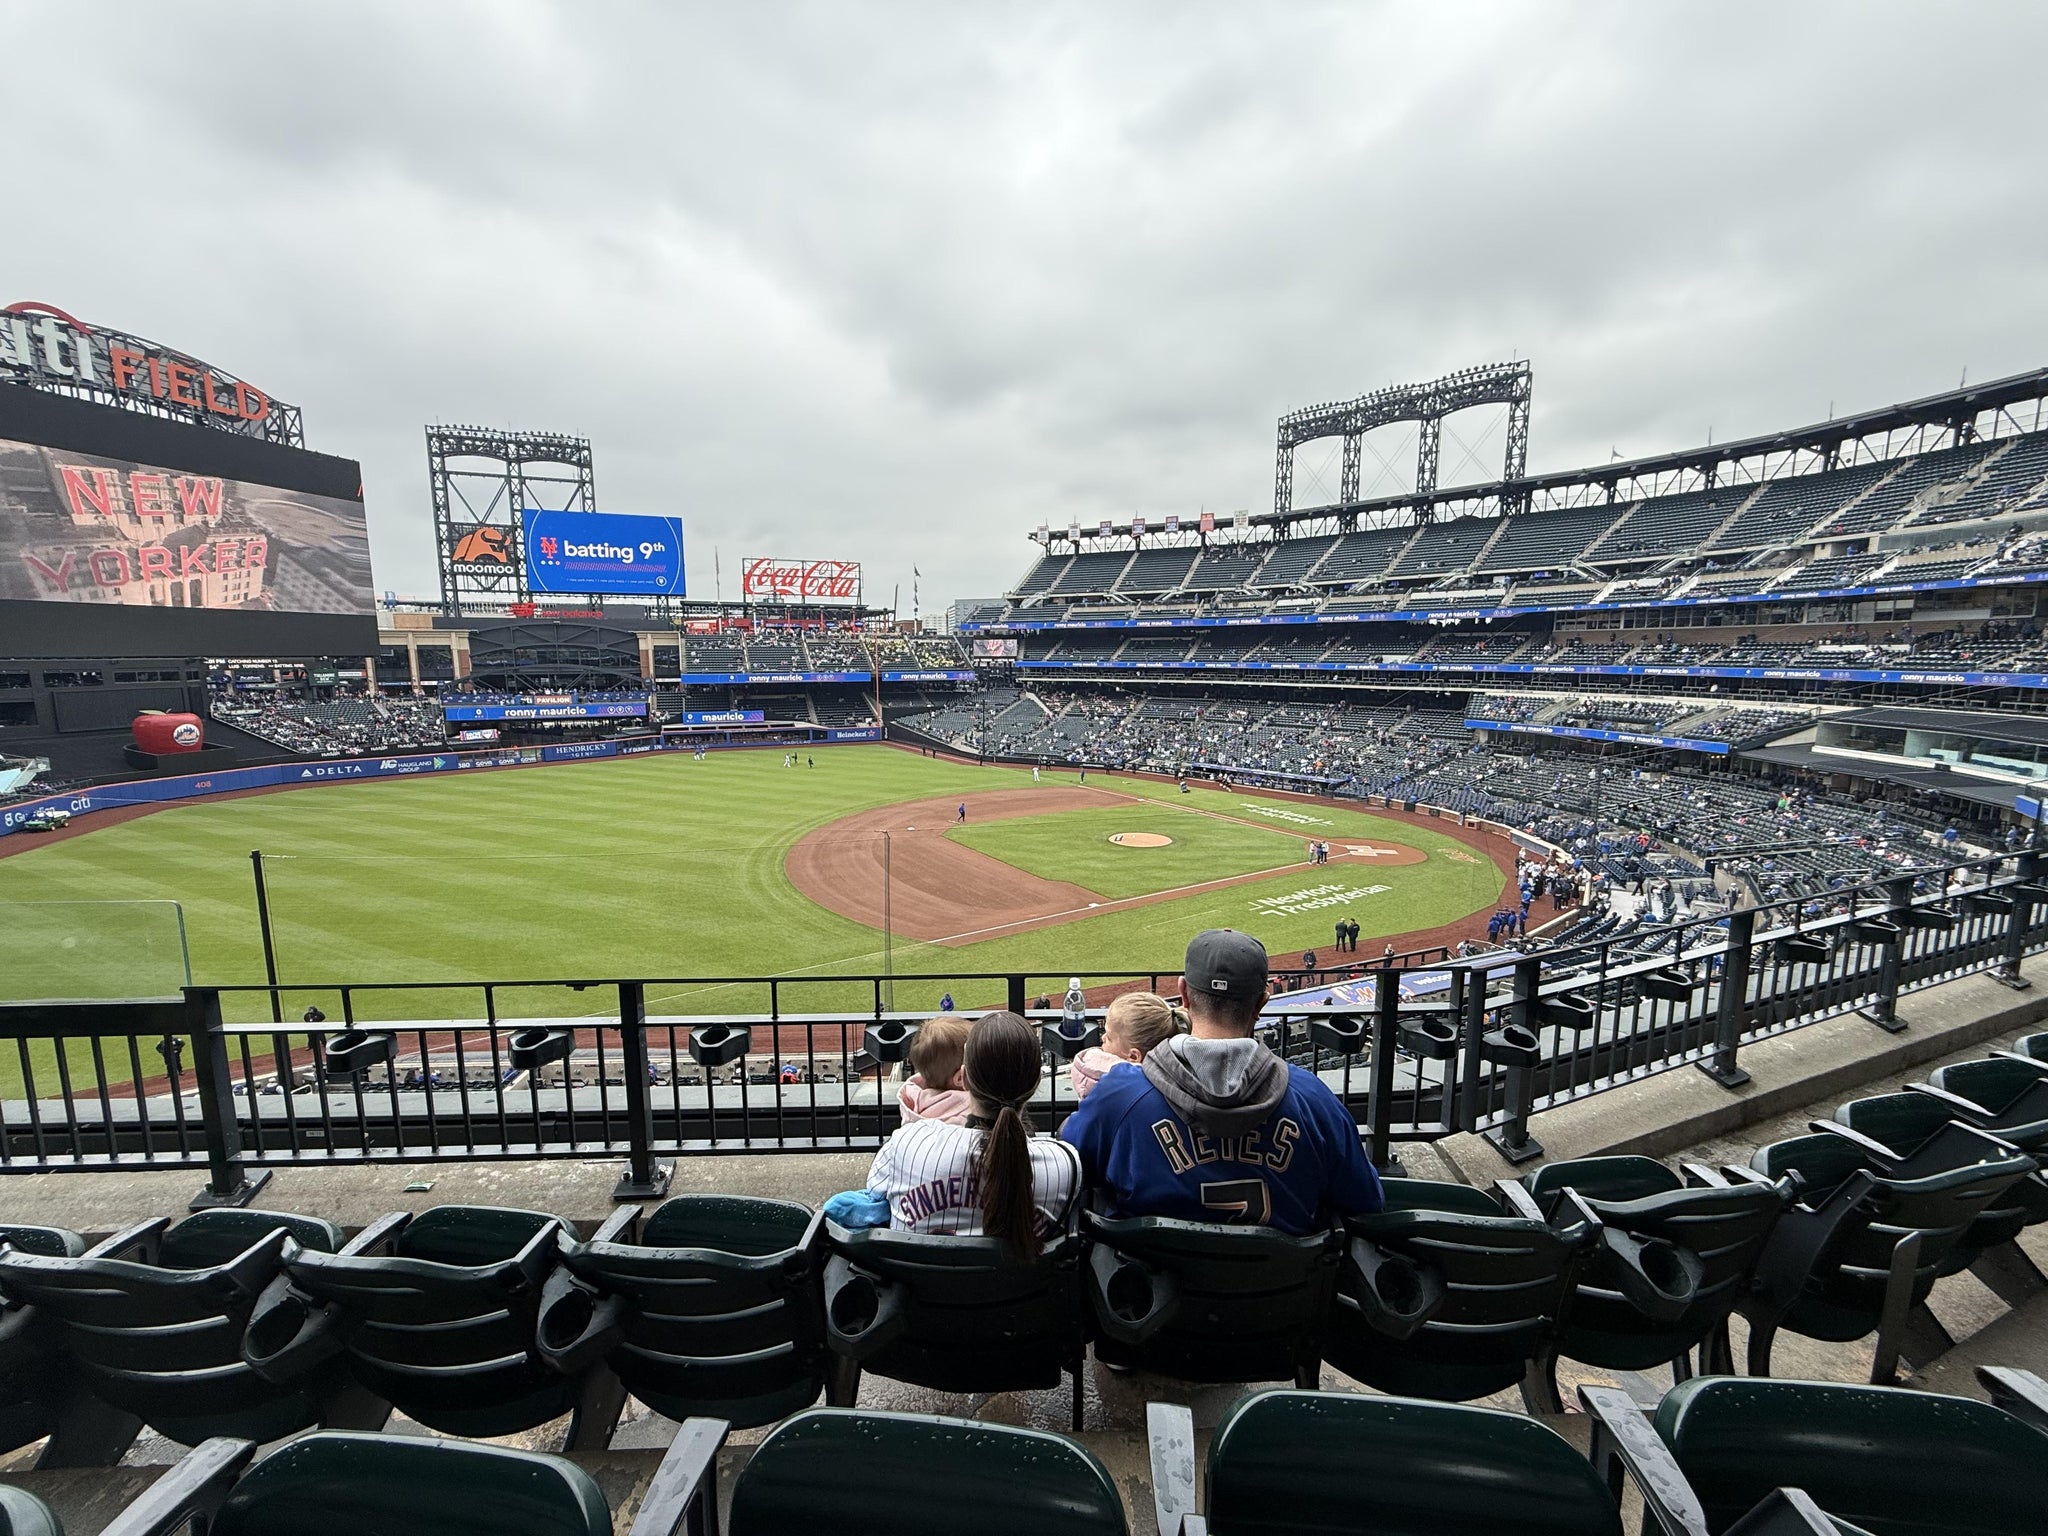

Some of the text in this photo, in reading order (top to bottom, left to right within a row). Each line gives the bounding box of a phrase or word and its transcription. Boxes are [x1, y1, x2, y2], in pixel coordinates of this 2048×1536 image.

[110, 346, 269, 421] FIELD
[61, 467, 222, 517] NEW
[564, 540, 666, 564] batting 9th
[23, 540, 268, 592] YORKER
[453, 563, 514, 574] moomoo
[749, 674, 803, 683] ronny mauricio
[1901, 673, 1964, 682] ronny mauricio
[505, 706, 587, 718] ronny mauricio
[702, 712, 744, 721] mauricio
[1636, 736, 1663, 744] mauricio
[556, 743, 606, 754] HENDRICK'S
[398, 760, 432, 768] HAUGLAND
[316, 765, 362, 775] DELTA
[71, 796, 91, 812] citi
[1283, 883, 1393, 914] Presbyterian
[1201, 1179, 1271, 1225] 7
